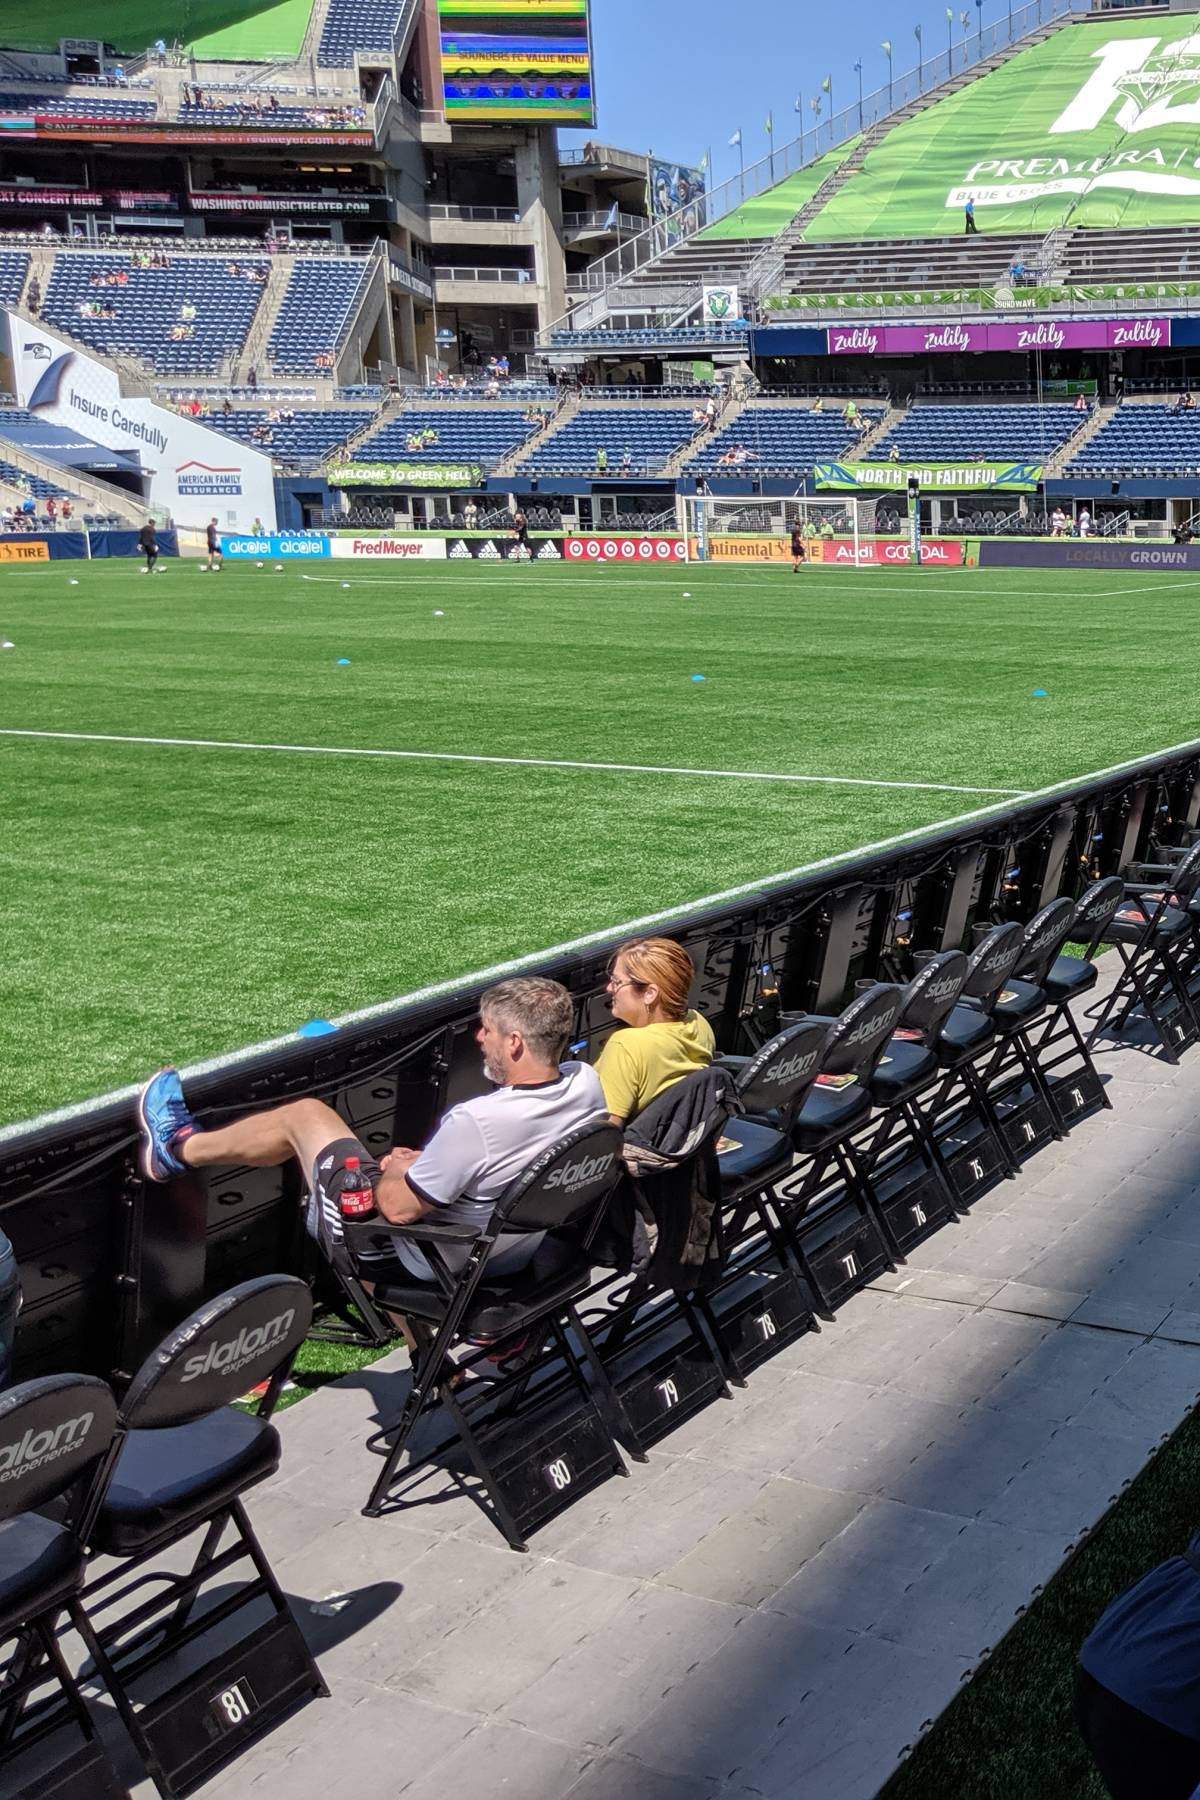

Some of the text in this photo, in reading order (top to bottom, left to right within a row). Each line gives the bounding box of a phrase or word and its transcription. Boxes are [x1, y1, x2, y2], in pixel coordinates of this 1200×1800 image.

[512, 54, 523, 62] FC
[526, 54, 556, 63] VALUE
[558, 55, 585, 64] MENU
[18, 192, 71, 205] CONCERT
[73, 194, 103, 206] HERE
[955, 188, 999, 202] BLUE
[70, 388, 168, 454] Insure Carefully
[178, 475, 241, 485] AMERICAN FAMILY
[335, 469, 472, 481] WELCOME TO GREEN HELL
[855, 468, 902, 484] NORTH
[936, 468, 997, 485] FAITHFUL
[182, 486, 238, 494] INSURANCE
[16, 546, 45, 558] TIRE
[229, 540, 323, 554] alcatel alcatel
[836, 545, 873, 558] Audi
[1130, 551, 1187, 564] GROWN
[845, 1005, 896, 1047] slalom
[762, 1050, 818, 1083] slalom
[1023, 1122, 1036, 1142] 74
[542, 1152, 614, 1190] slalom
[971, 1158, 984, 1180] 75
[912, 1205, 927, 1225] 76
[760, 1314, 777, 1337] 78
[180, 1308, 296, 1383] slalom
[221, 1330, 289, 1376] experience
[659, 1379, 679, 1405] 79
[0, 1411, 95, 1471] alom
[1, 1436, 85, 1483] experience
[549, 1461, 571, 1489] 80
[222, 1684, 251, 1723] 81
